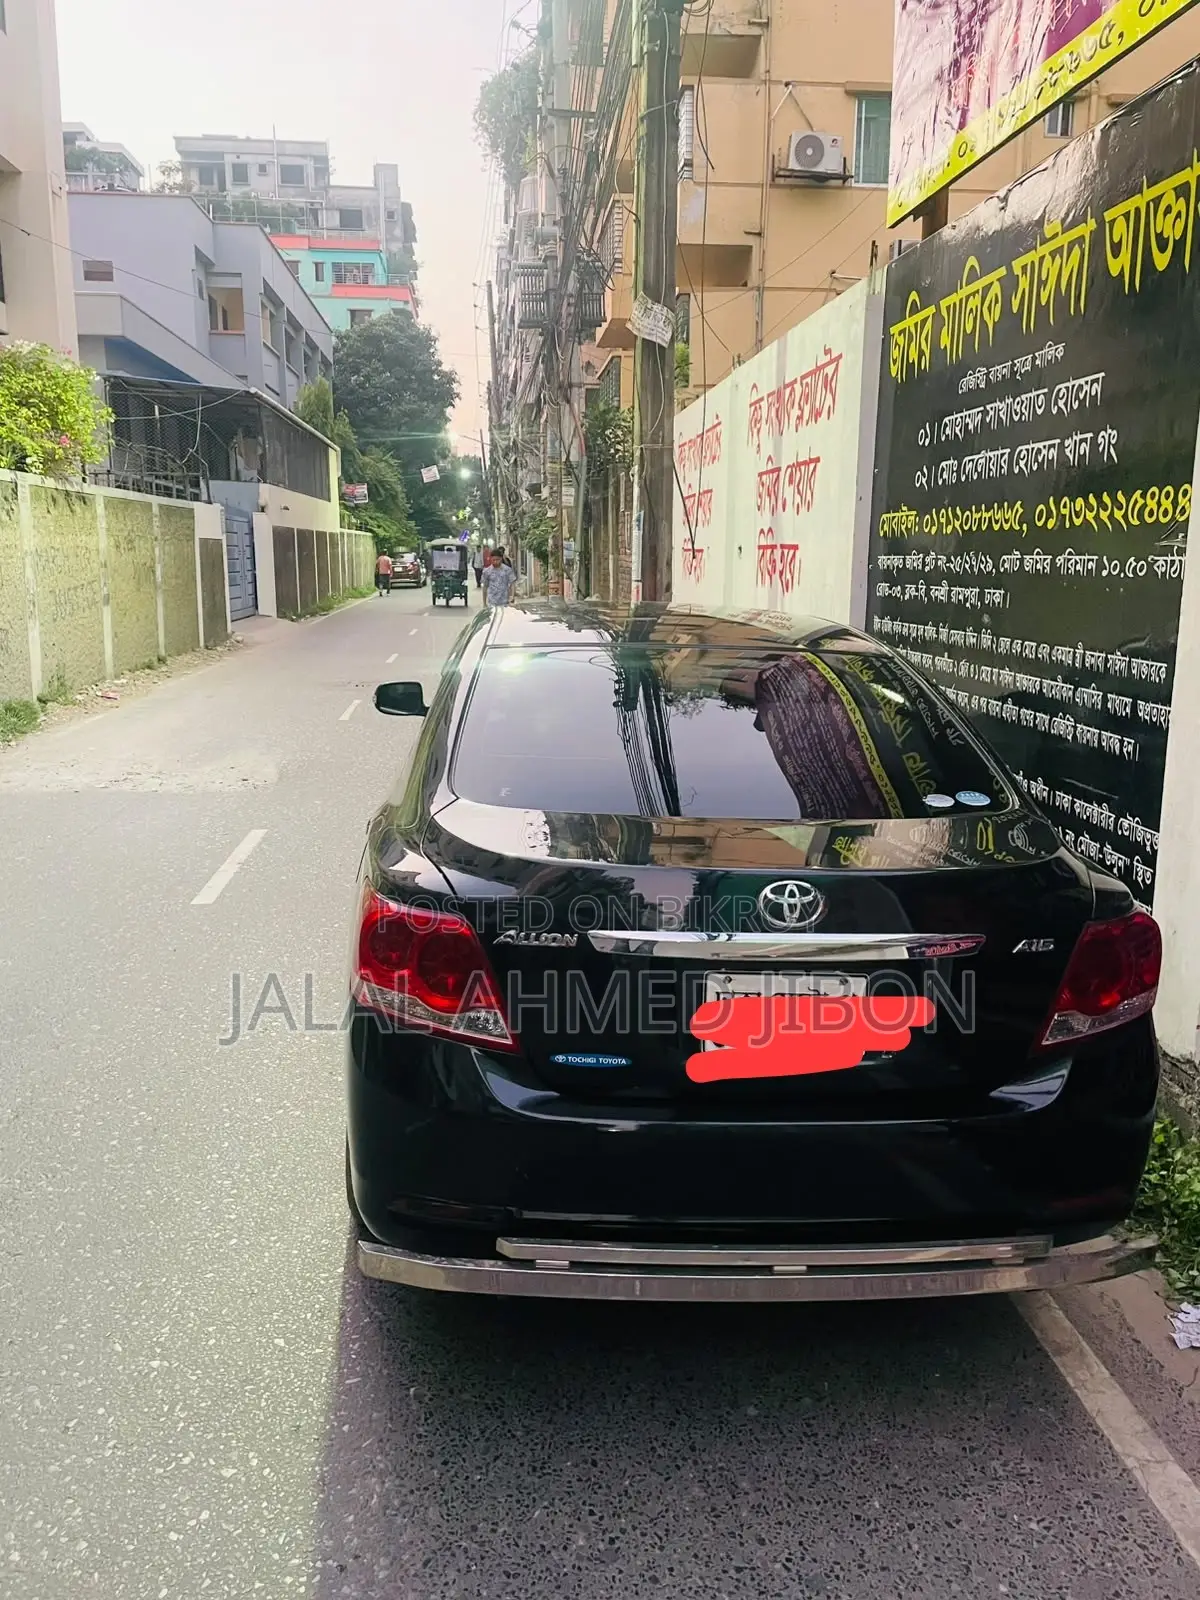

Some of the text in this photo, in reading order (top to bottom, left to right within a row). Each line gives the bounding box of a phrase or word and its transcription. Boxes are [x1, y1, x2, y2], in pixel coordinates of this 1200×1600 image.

[890, 291, 936, 383] জমির
[940, 255, 1007, 365] মালিক
[1104, 148, 1200, 295] আক্তা
[989, 360, 1012, 384] বায়না
[1035, 341, 1066, 368] মালিক
[941, 407, 984, 442] মোহাম্মদ
[986, 387, 1048, 430] সাখাওয়াত
[1051, 372, 1106, 418] হোসেন
[1013, 439, 1061, 478] হোসেন
[1065, 430, 1094, 467] খান
[1098, 424, 1118, 463] গং
[757, 455, 781, 516] জমির
[923, 500, 1028, 538] ০১৭১২০৮৮৬৬৫,
[1000, 548, 1021, 573] মোট
[1023, 547, 1052, 574] জমির
[1055, 547, 1098, 577] পরিমান
[1101, 555, 1147, 578] ১০.৫০
[1150, 545, 1186, 580] কাঠা
[930, 580, 949, 604] বনশ্রী
[950, 585, 981, 609] রামপুরা,
[1037, 643, 1050, 664] এবং
[1130, 657, 1168, 684] আক্তারকে
[1107, 692, 1133, 719] মাধ্যমে
[1055, 790, 1072, 814] ঢাকা
[599, 1057, 626, 1065] TOYOTA
